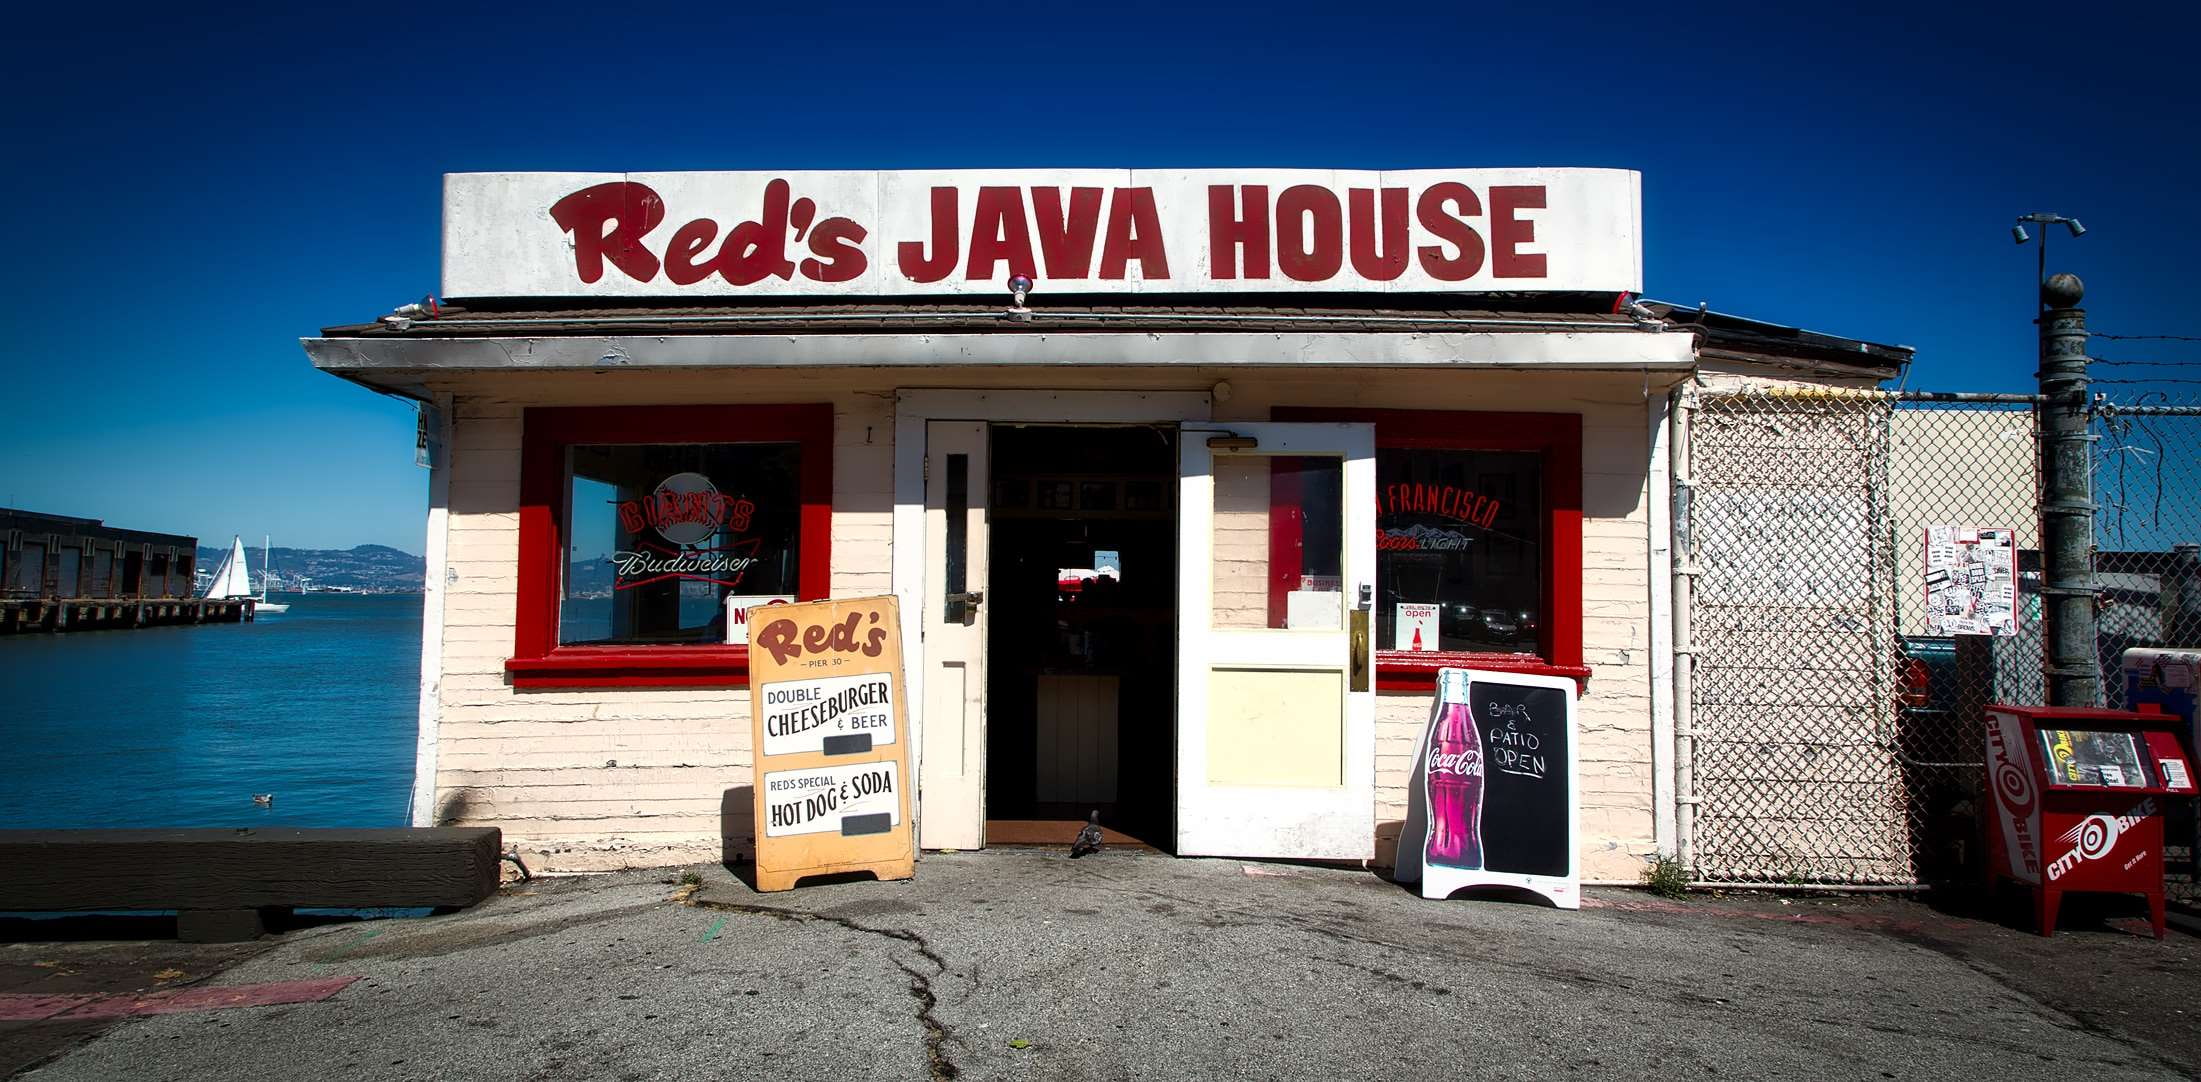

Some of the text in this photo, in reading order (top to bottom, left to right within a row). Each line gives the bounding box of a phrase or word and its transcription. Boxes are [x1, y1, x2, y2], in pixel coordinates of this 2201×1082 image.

[549, 178, 1547, 286] Red's JAVA HOUSE
[619, 490, 755, 534] GIANTS
[1387, 482, 1500, 529] FRANCISCO
[1420, 538, 1475, 550] LIGHT
[612, 551, 759, 576] Budweiser
[1405, 610, 1431, 618] open
[757, 612, 887, 666] Red's
[809, 658, 842, 669] PIER 30
[768, 687, 821, 705] DOUBLE
[768, 682, 888, 737] CHEESEBURGER
[852, 714, 887, 729] BEER
[1489, 701, 1532, 722] BAR
[1490, 727, 1540, 750] PATIO
[1494, 746, 1546, 773] OPEN
[770, 775, 836, 791] RED'S SPECIAL
[1985, 714, 2041, 874] CITY BIKE
[771, 800, 802, 828] HOT
[807, 788, 837, 822] DOG
[852, 771, 892, 799] SODA
[2047, 797, 2157, 881] CITY BIKE
